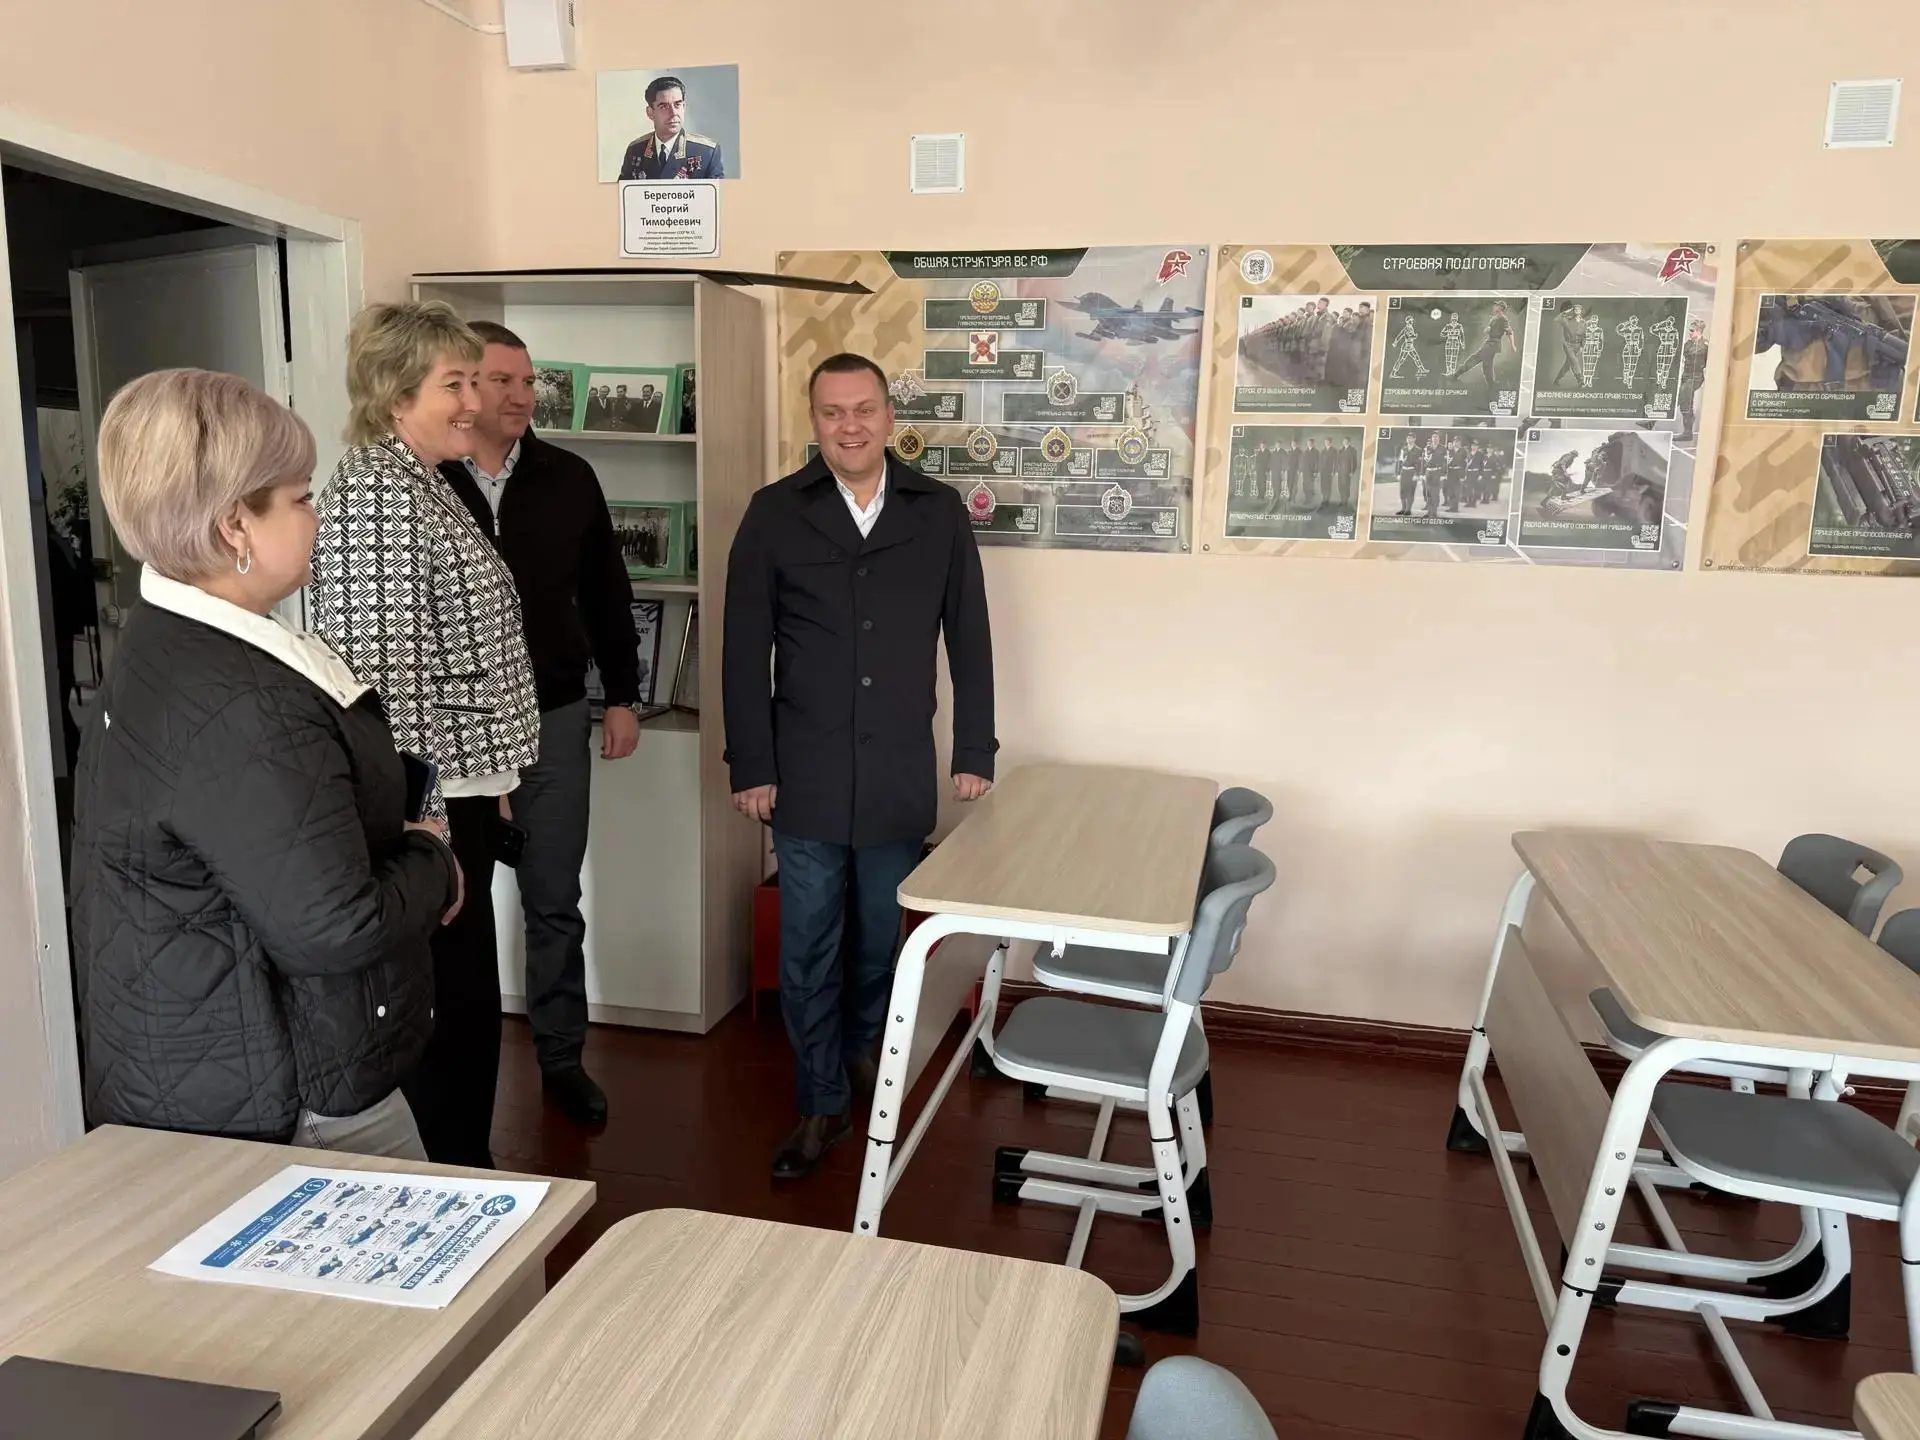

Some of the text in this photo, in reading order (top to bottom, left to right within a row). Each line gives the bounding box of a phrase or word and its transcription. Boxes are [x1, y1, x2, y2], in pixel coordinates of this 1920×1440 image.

[644, 190, 695, 201] Береговой
[651, 204, 689, 215] Георгий
[640, 217, 701, 228] Тимофеевич
[913, 255, 1048, 268] ОБЩАЯ СТРУКТУРА ВС РФ
[1383, 257, 1526, 270] СТРОЕВАЯ ПОДГОТОВКА
[1536, 391, 1643, 400] ВЫПОЛНЕНИЕ ВОИНСКОГО ПРИВЕТСТВИЯ
[1752, 392, 1781, 400] ПРАВИЛА
[1781, 392, 1820, 400] БЕЗОПАСНОГО
[1814, 529, 1853, 537] ПРИЦЕЛЬНОЕ
[1853, 530, 1904, 539] ПРИСПОСОБЛЕНИЕ
[433, 1215, 481, 1259] ПРОВАЛИЛИСЬ
[469, 1218, 501, 1248] ПОРЯДОК
[450, 1236, 472, 1254] ЕСЛИ
[428, 1249, 470, 1286] ДЕЙСТВИЙ,
